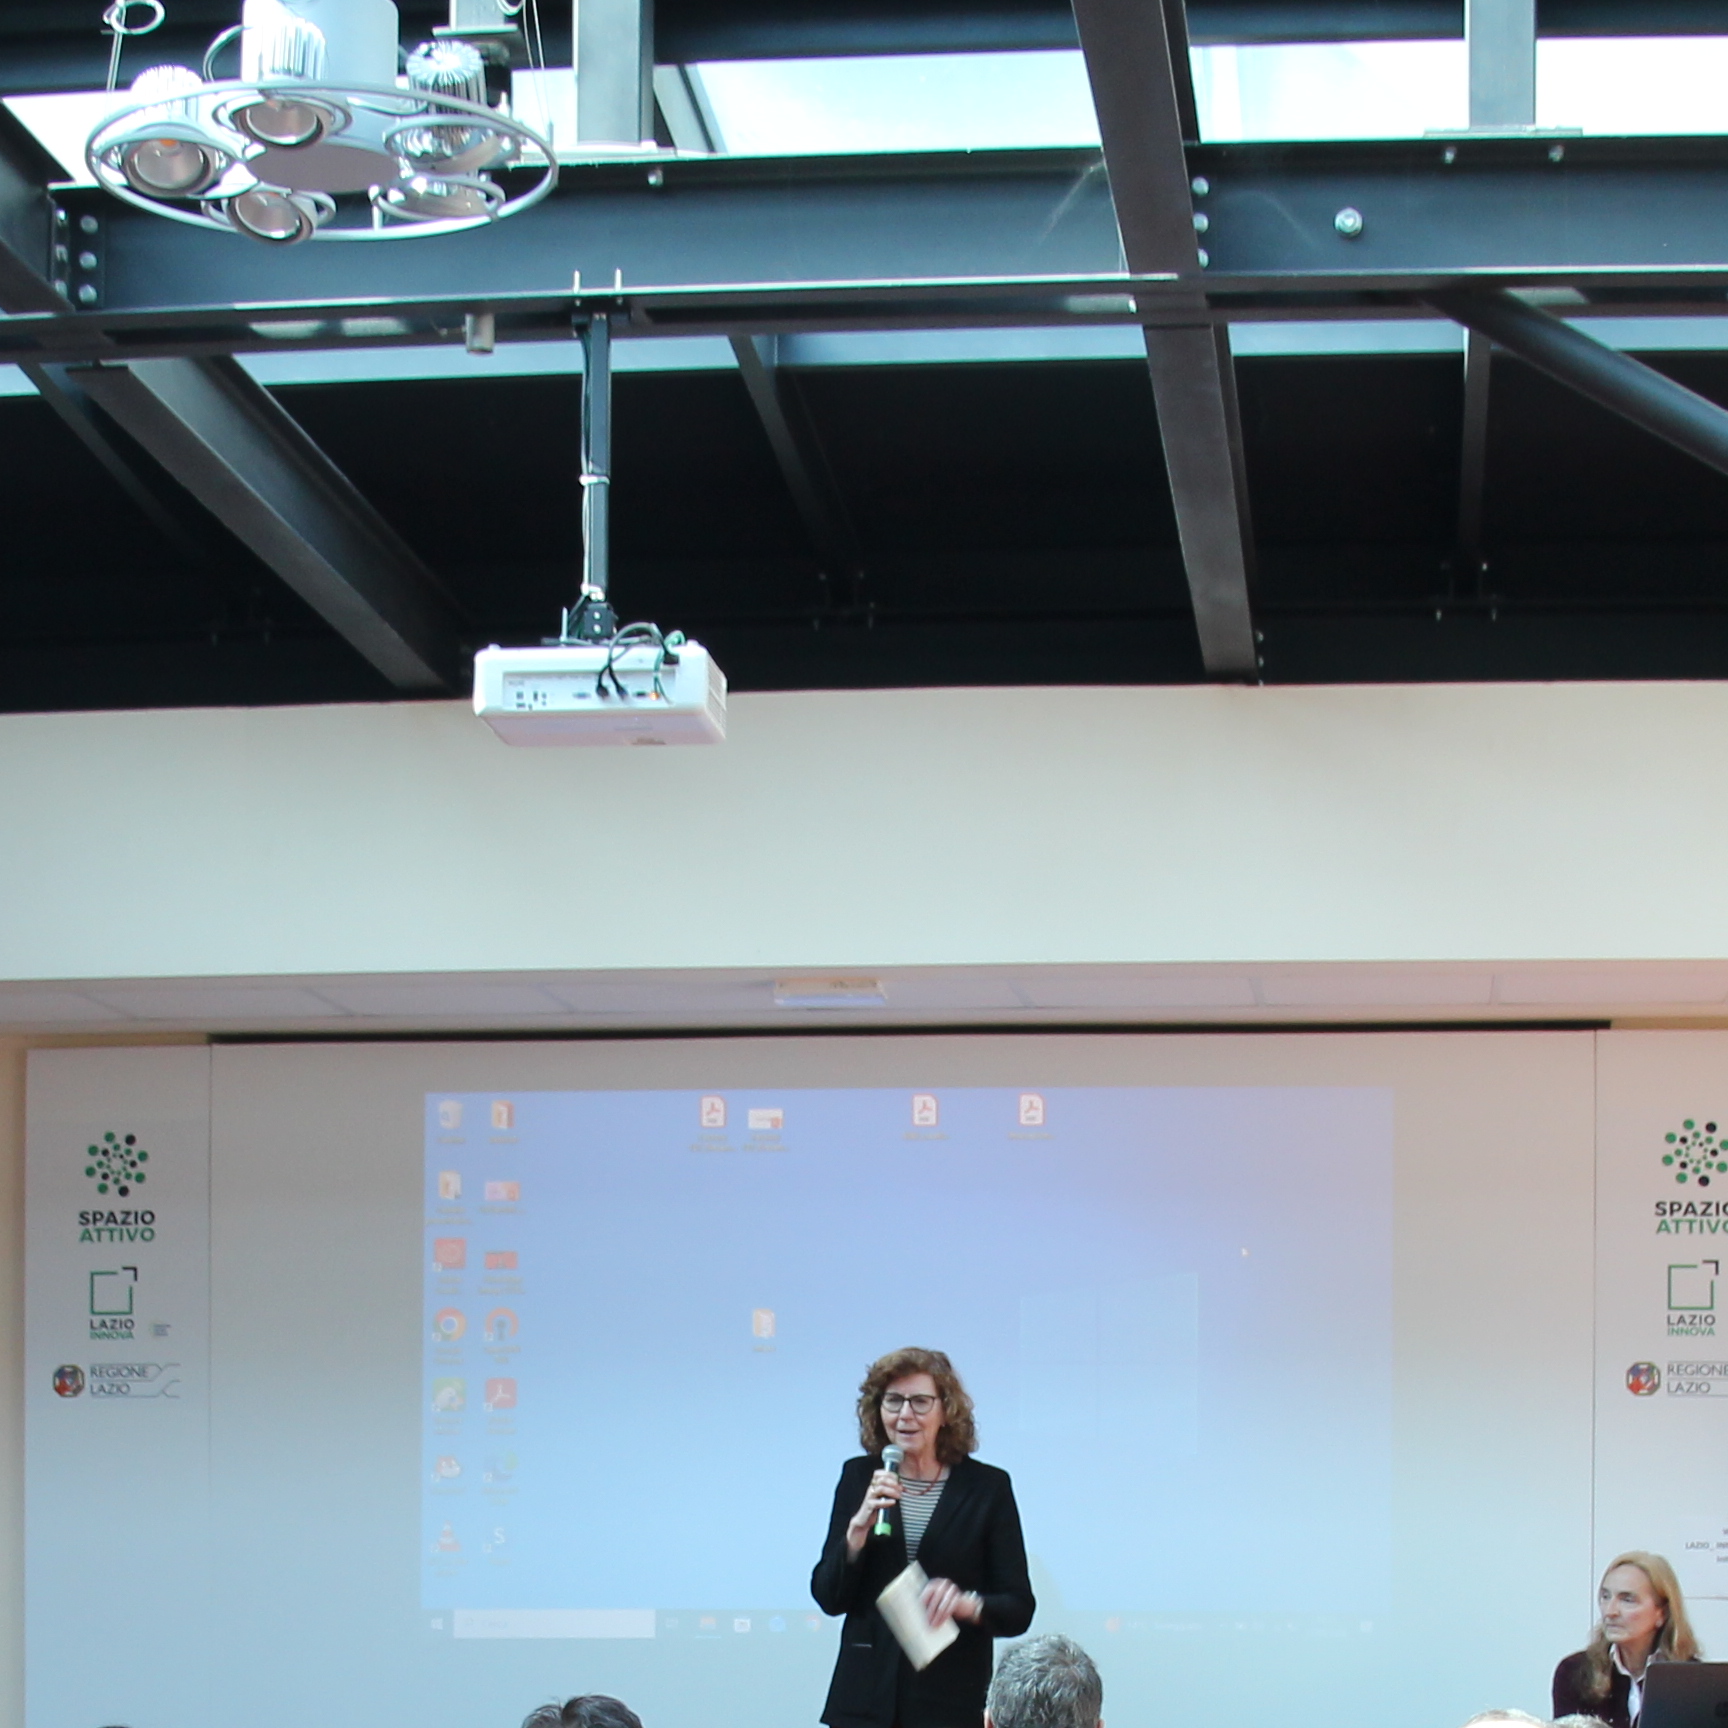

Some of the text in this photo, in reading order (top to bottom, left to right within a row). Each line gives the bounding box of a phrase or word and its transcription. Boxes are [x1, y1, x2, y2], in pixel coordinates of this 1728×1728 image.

[78, 1209, 156, 1226] SPAZIO
[78, 1227, 156, 1243] ATTIVO
[89, 1318, 135, 1331] LAZIO
[1666, 1314, 1716, 1326] LAZIO
[1667, 1326, 1716, 1337] INNOVA
[89, 1364, 149, 1379] REGIONE
[89, 1382, 131, 1396] LAZIO
[1667, 1381, 1711, 1395] LAZIO
